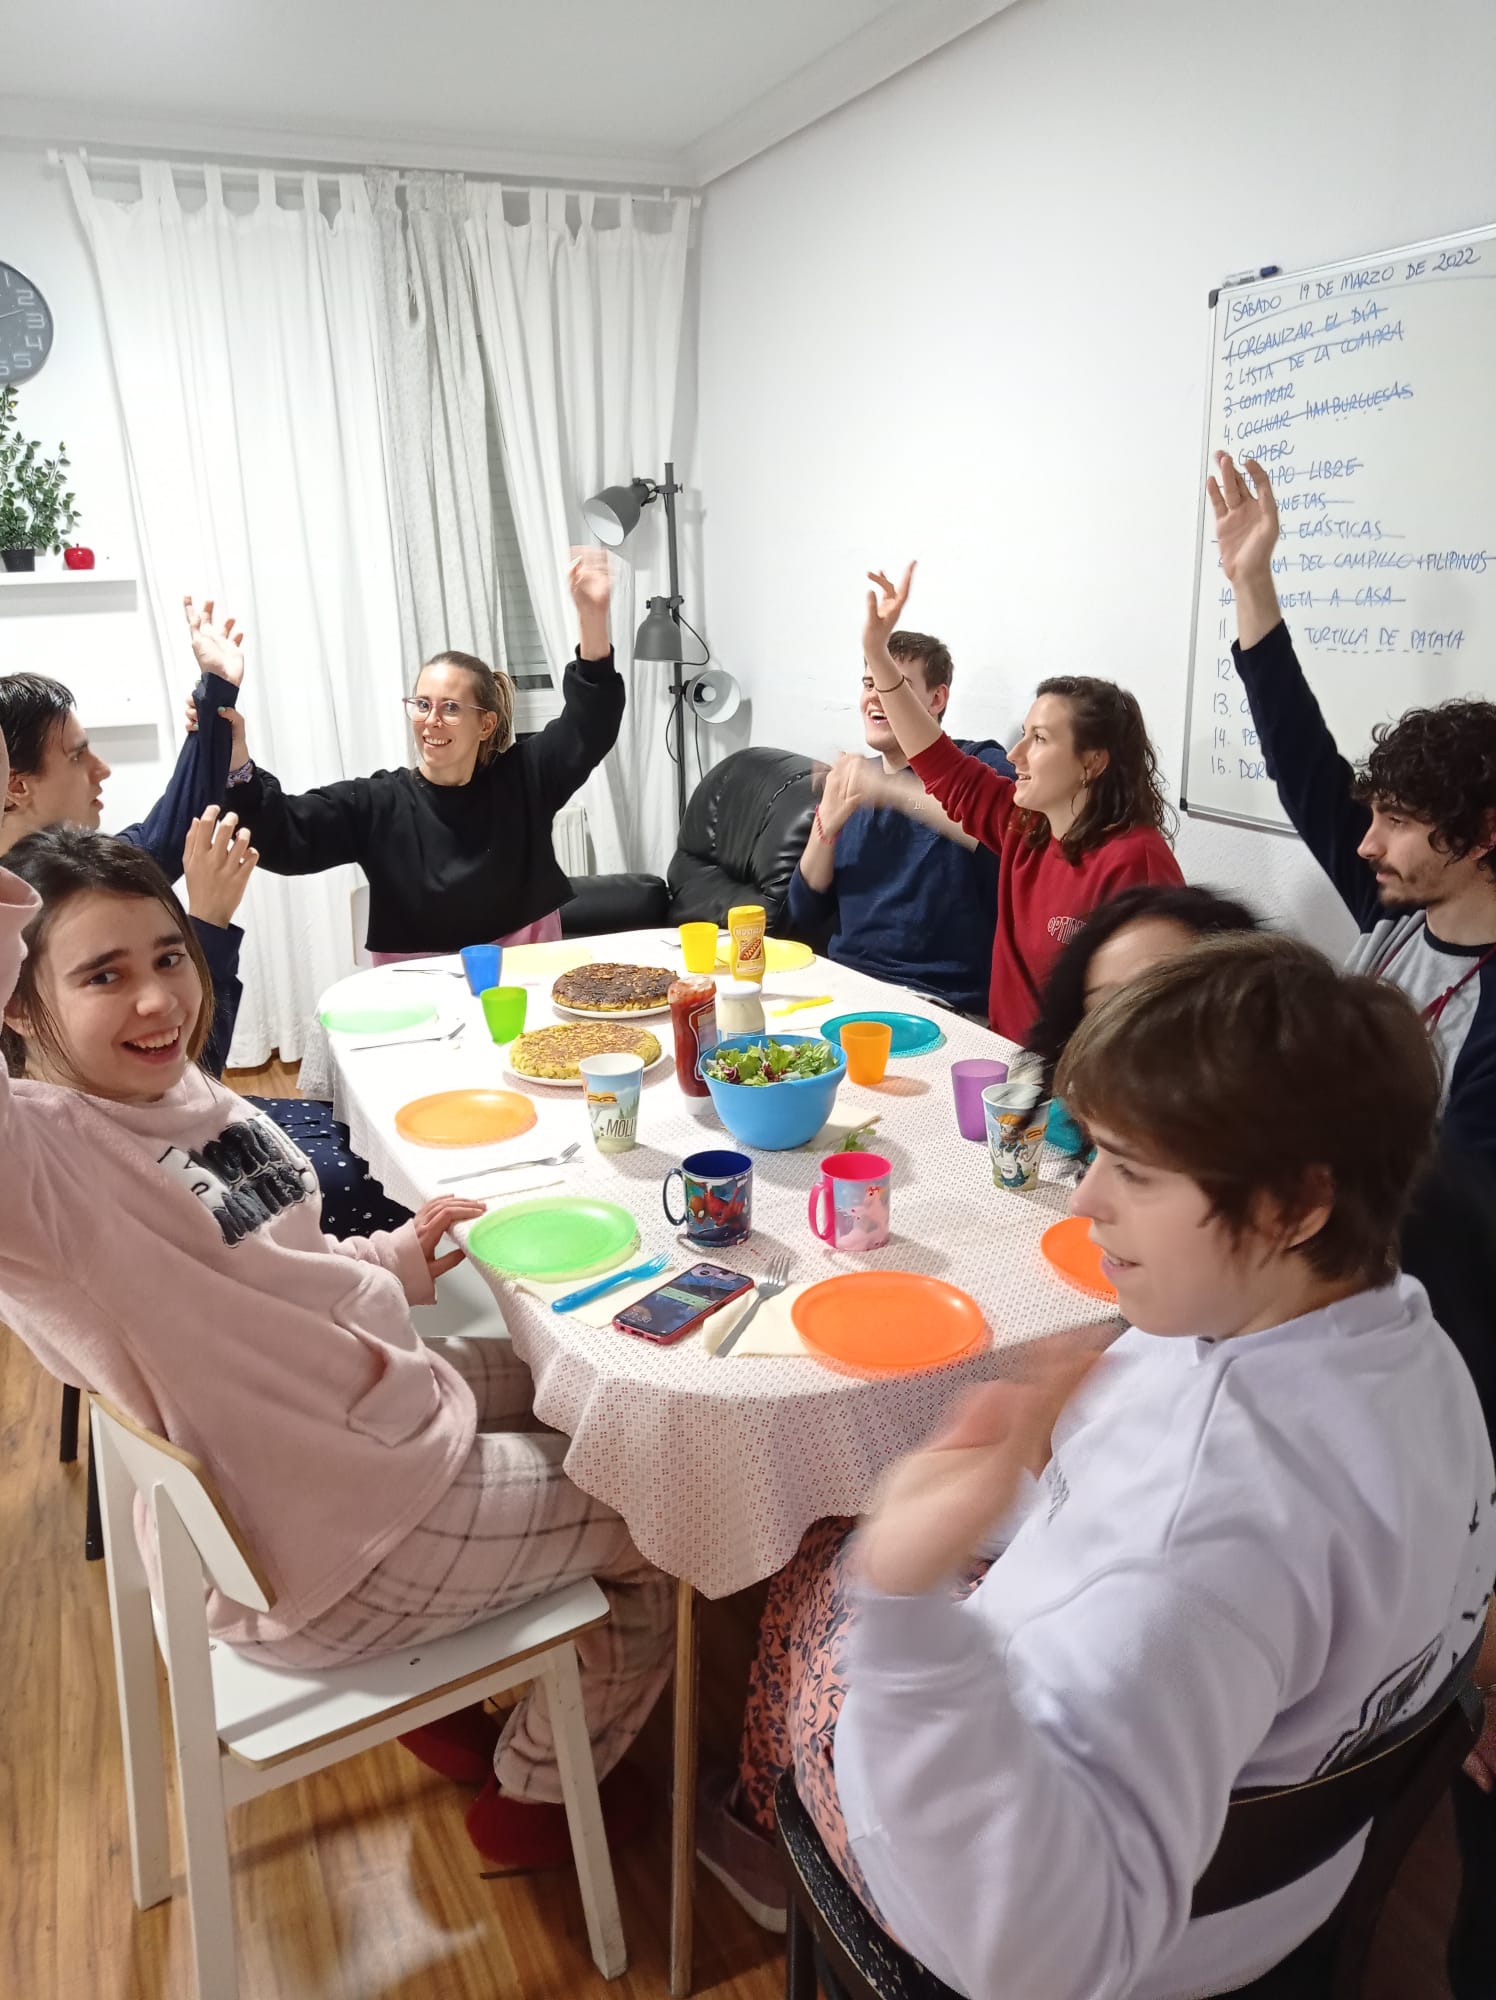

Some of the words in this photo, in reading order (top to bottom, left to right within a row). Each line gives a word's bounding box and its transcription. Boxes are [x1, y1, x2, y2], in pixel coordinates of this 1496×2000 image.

[1300, 282, 1310, 300] 19
[1317, 281, 1334, 299] DE
[1341, 267, 1395, 291] MARZO
[1406, 260, 1426, 281] DE
[1432, 247, 1482, 273] 2022
[16, 289, 35, 306] 2
[26, 312, 46, 329] 3
[25, 335, 43, 351] 4
[1238, 321, 1315, 360] ORGANIZAR
[1325, 312, 1338, 332] EL
[13, 352, 32, 369] 5
[1239, 363, 1274, 386] LISTA
[1289, 354, 1305, 372] DE
[1314, 345, 1331, 364] LA
[1341, 320, 1405, 354] COMPRA
[1240, 382, 1295, 410] COMPRAR
[1237, 410, 1292, 439] COCINAR
[1306, 381, 1414, 420] HAMBURGUESAS
[1309, 457, 1357, 480] LIBRE
[1300, 513, 1383, 540] ELÁSTICAS
[1330, 588, 1340, 608] A
[1355, 585, 1392, 607] CASA
[1304, 627, 1368, 645] TORTILLA
[1380, 627, 1400, 646] DE
[1411, 629, 1465, 650] PATATA
[1239, 758, 1268, 780] DOR
